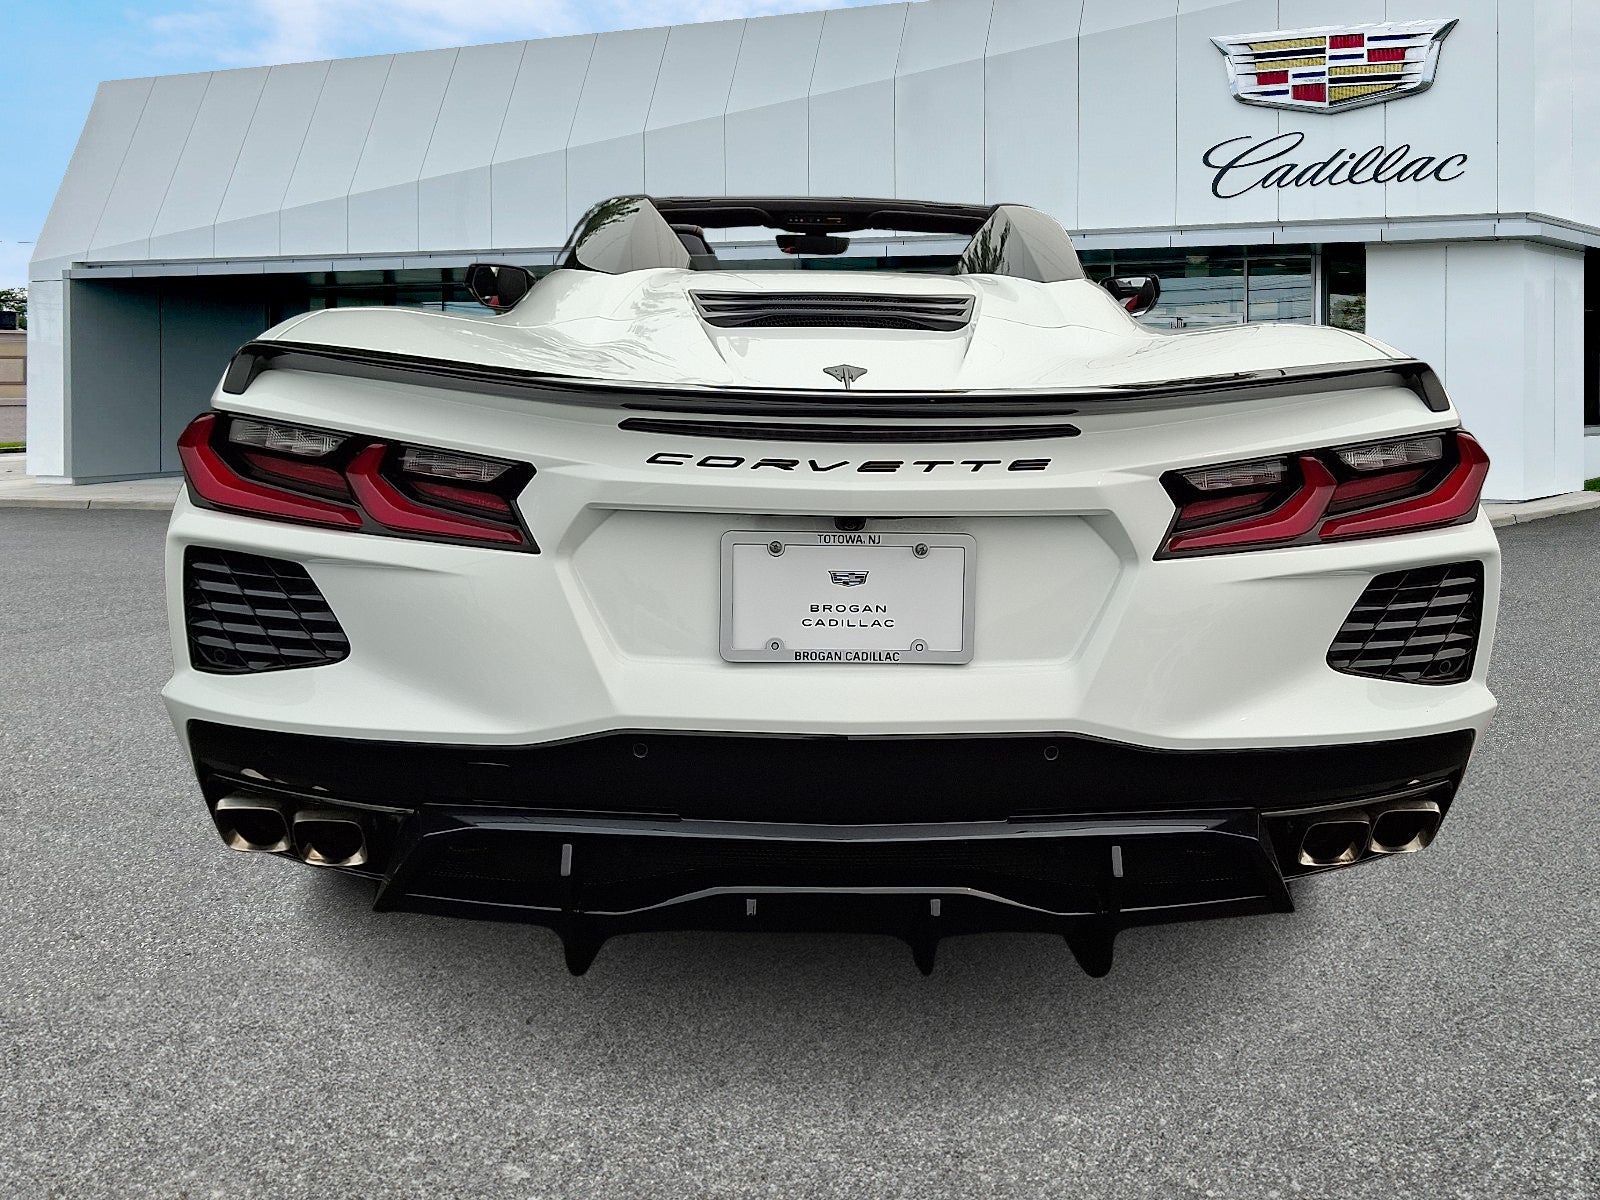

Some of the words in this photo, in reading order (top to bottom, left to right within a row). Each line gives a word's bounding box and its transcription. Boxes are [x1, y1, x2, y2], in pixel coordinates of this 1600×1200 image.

[1202, 131, 1468, 199] Cadillac
[646, 452, 1052, 473] CORVETTE
[868, 534, 881, 545] NJ
[810, 604, 887, 613] BROGAN
[801, 618, 895, 628] CADILLAC
[794, 651, 842, 662] BROGAN
[845, 651, 900, 662] CADILLAC
